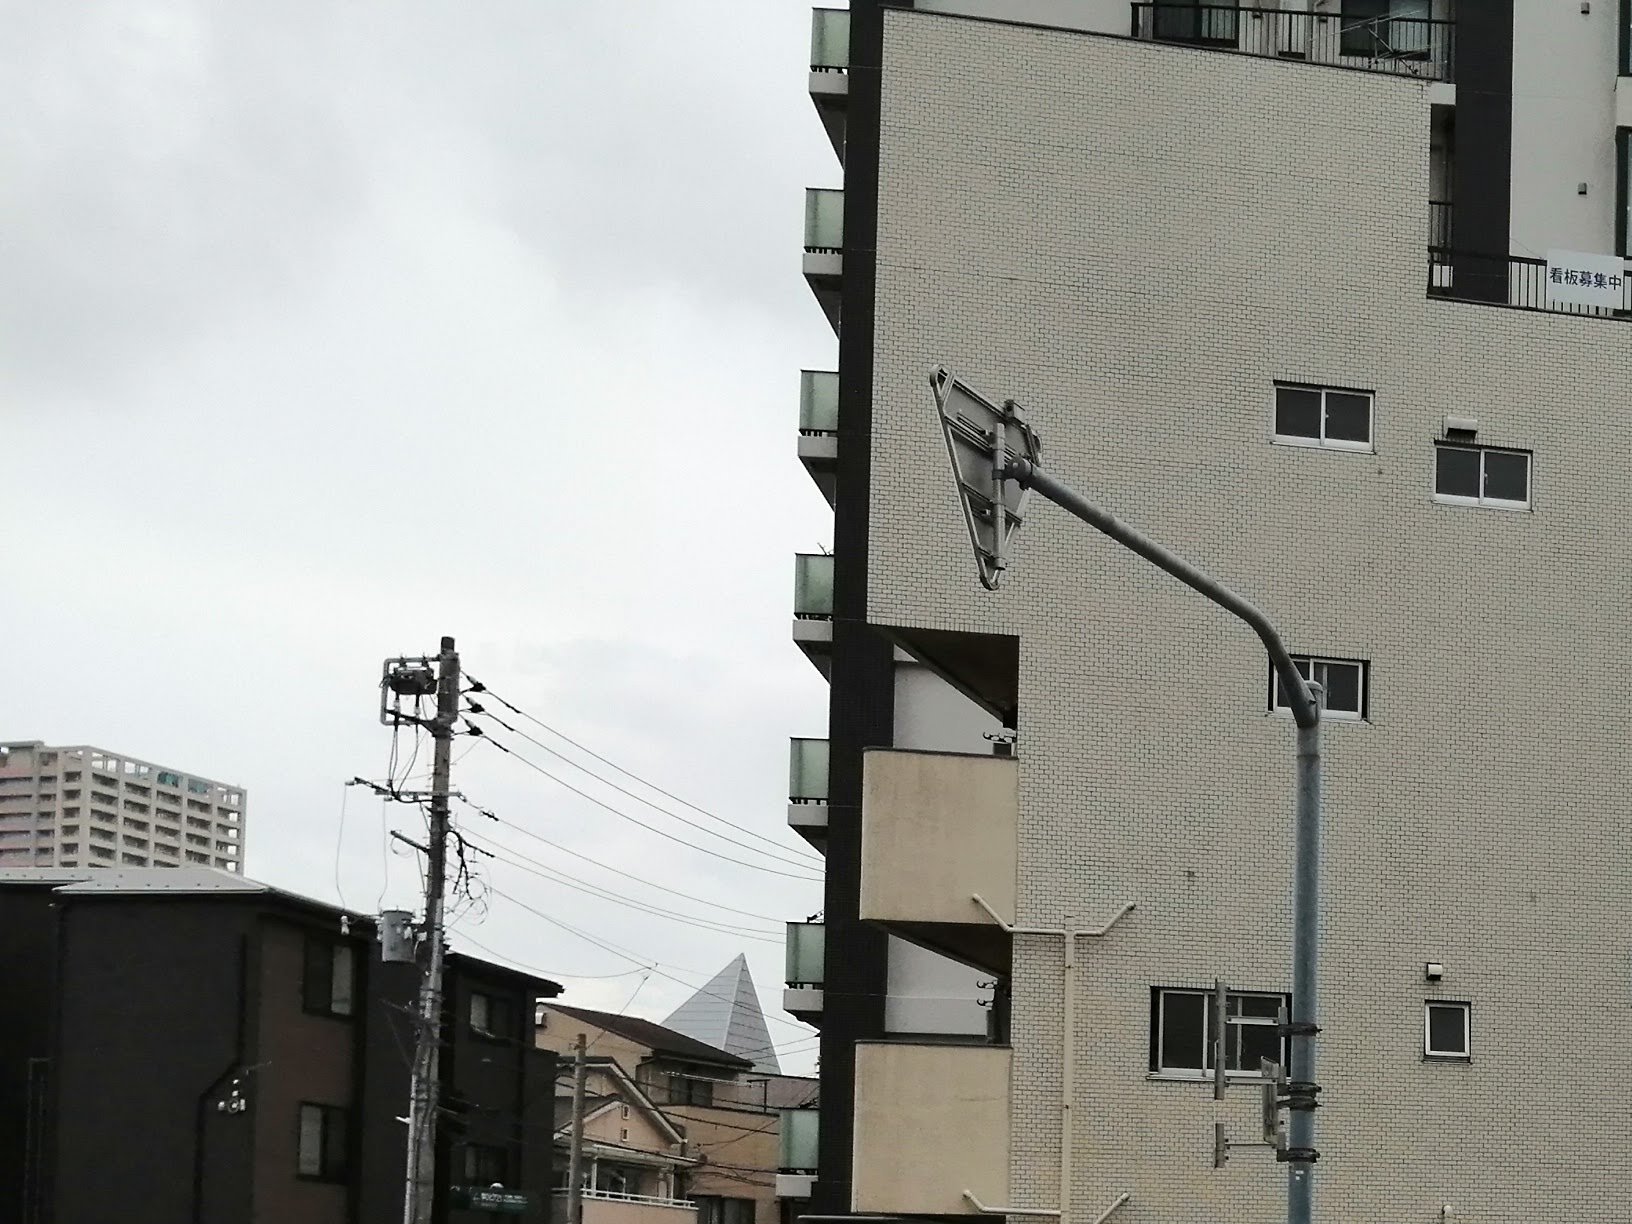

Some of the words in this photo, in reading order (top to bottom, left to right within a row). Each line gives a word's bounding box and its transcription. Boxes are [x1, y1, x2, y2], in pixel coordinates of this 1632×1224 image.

[1549, 267, 1622, 290] 看板募集中
